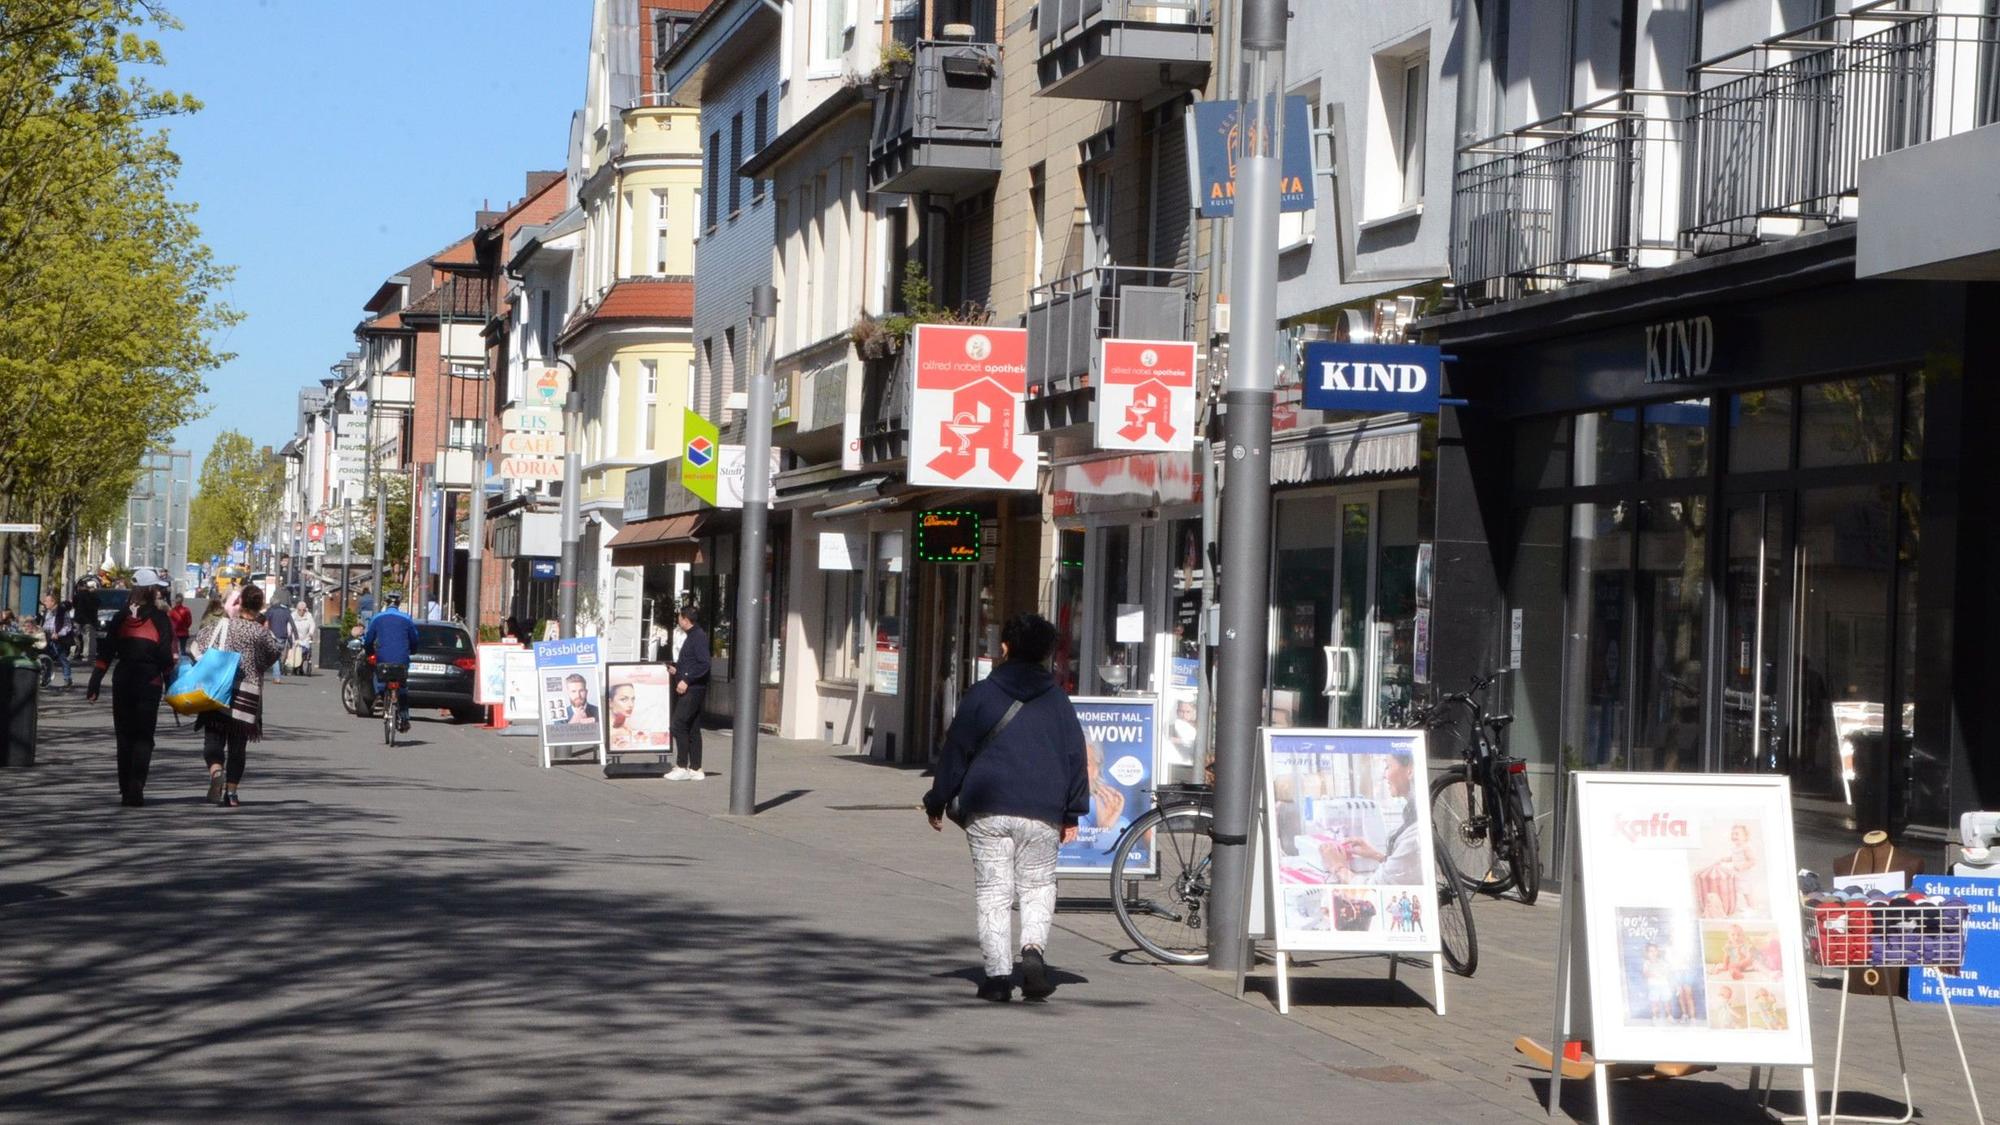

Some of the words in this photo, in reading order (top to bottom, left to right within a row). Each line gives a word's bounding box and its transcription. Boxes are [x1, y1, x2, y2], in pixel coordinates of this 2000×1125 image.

[1211, 176, 1304, 199] ANYA
[1643, 315, 1714, 384] KIND
[922, 359, 952, 370] alfred
[953, 361, 982, 372] nobel
[984, 363, 1026, 375] apothek
[1319, 361, 1427, 393] KIND
[520, 415, 547, 428] EIS
[502, 459, 560, 478] ADRIA
[538, 643, 596, 657] Passbilder
[1077, 712, 1120, 722] MOMENT
[1121, 713, 1143, 722] MAL
[1089, 725, 1144, 743] WOW!
[1614, 812, 1688, 843] katia
[1977, 984, 2000, 999] WER
